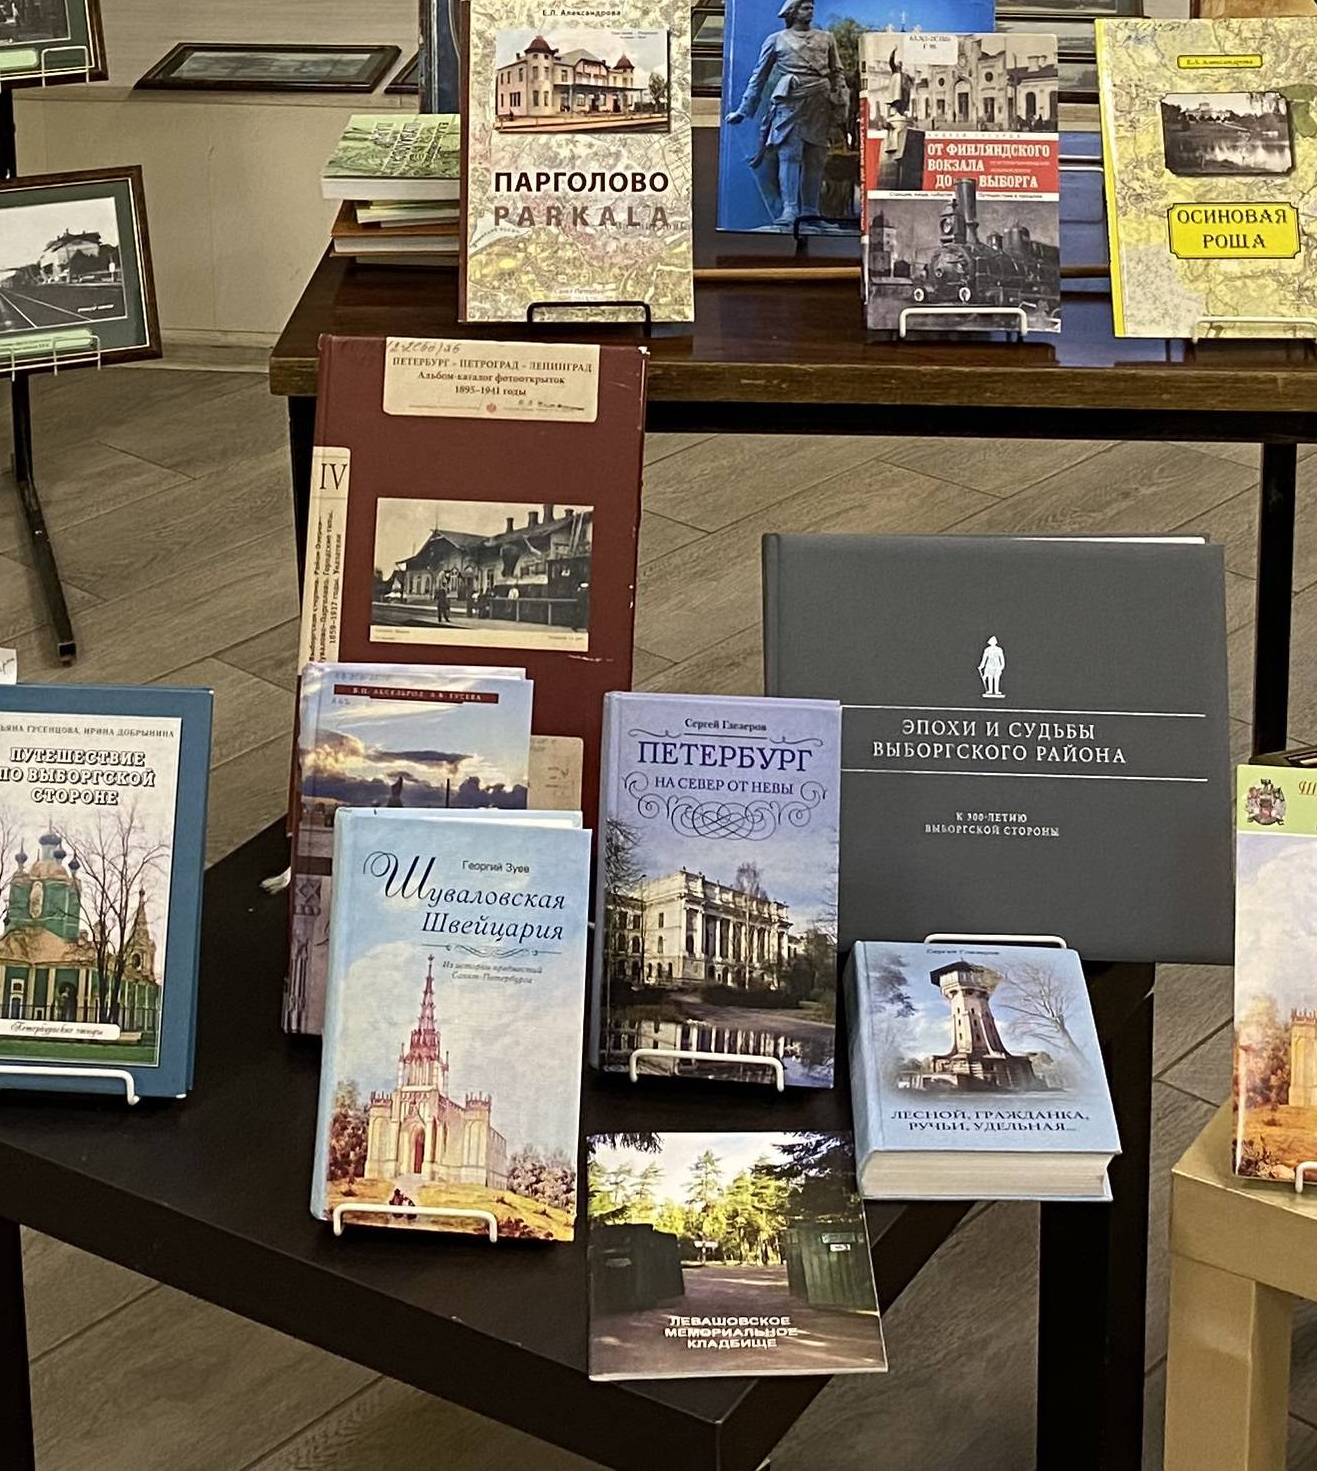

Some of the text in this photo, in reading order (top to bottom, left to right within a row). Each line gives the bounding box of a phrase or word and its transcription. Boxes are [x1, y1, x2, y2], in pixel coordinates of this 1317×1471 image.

[561, 9, 622, 18] Александрова
[927, 142, 1051, 159] ОТ ФИНЛЯНДСКОГО
[927, 159, 985, 173] ВОКЗАЛА
[494, 171, 670, 194] ПАРГОЛОВО
[935, 175, 1039, 190] ДО ВЫБОРГА
[493, 204, 669, 228] PARKALA
[1177, 207, 1288, 226] ОСИНОВАЯ
[1201, 232, 1267, 251] РОЩА
[392, 356, 450, 369] ПЕТЕРБУРГ
[459, 358, 519, 371] ПЕТРОГРАД
[494, 373, 566, 385] фотооткрыток
[503, 387, 527, 397] годы
[319, 462, 349, 491] IV
[83, 727, 115, 737] ИРИНА
[684, 718, 768, 733] Сергей Глезеров
[900, 719, 1096, 741] ЭПОХИ И СУДЬБЫ
[9, 746, 146, 768] ПУТЕШЕСТВИЕ
[637, 739, 813, 772] ПЕТЕРБУРГ
[872, 742, 1127, 765] ВЫБОРГСКОГО РАЙОНА
[26, 767, 156, 788] ВЫБОРГСКОЙ
[654, 776, 795, 796] НА СЕВЕР ОТ НЕВЫ
[29, 788, 119, 806] СТОРОНЕ
[955, 811, 1028, 824] К 300-ЛЕТИЮ
[924, 823, 1060, 838] ВЫБОРГСКОЙ СТОРОНЫ
[461, 859, 531, 875] Георгий Зуев
[362, 850, 566, 911] Шуваловская
[421, 911, 564, 944] Швейцария
[890, 1108, 1090, 1122] ЛЕСНОЙ, ГРАЖДАНКА,
[908, 1121, 970, 1133] РУЧЬИ,
[669, 1315, 792, 1327] ЛЕВАШОВСКОЕ
[664, 1327, 799, 1339] МЕМОРИАЛЬНОЕ
[687, 1338, 778, 1351] КЛАДБИЩЕ
